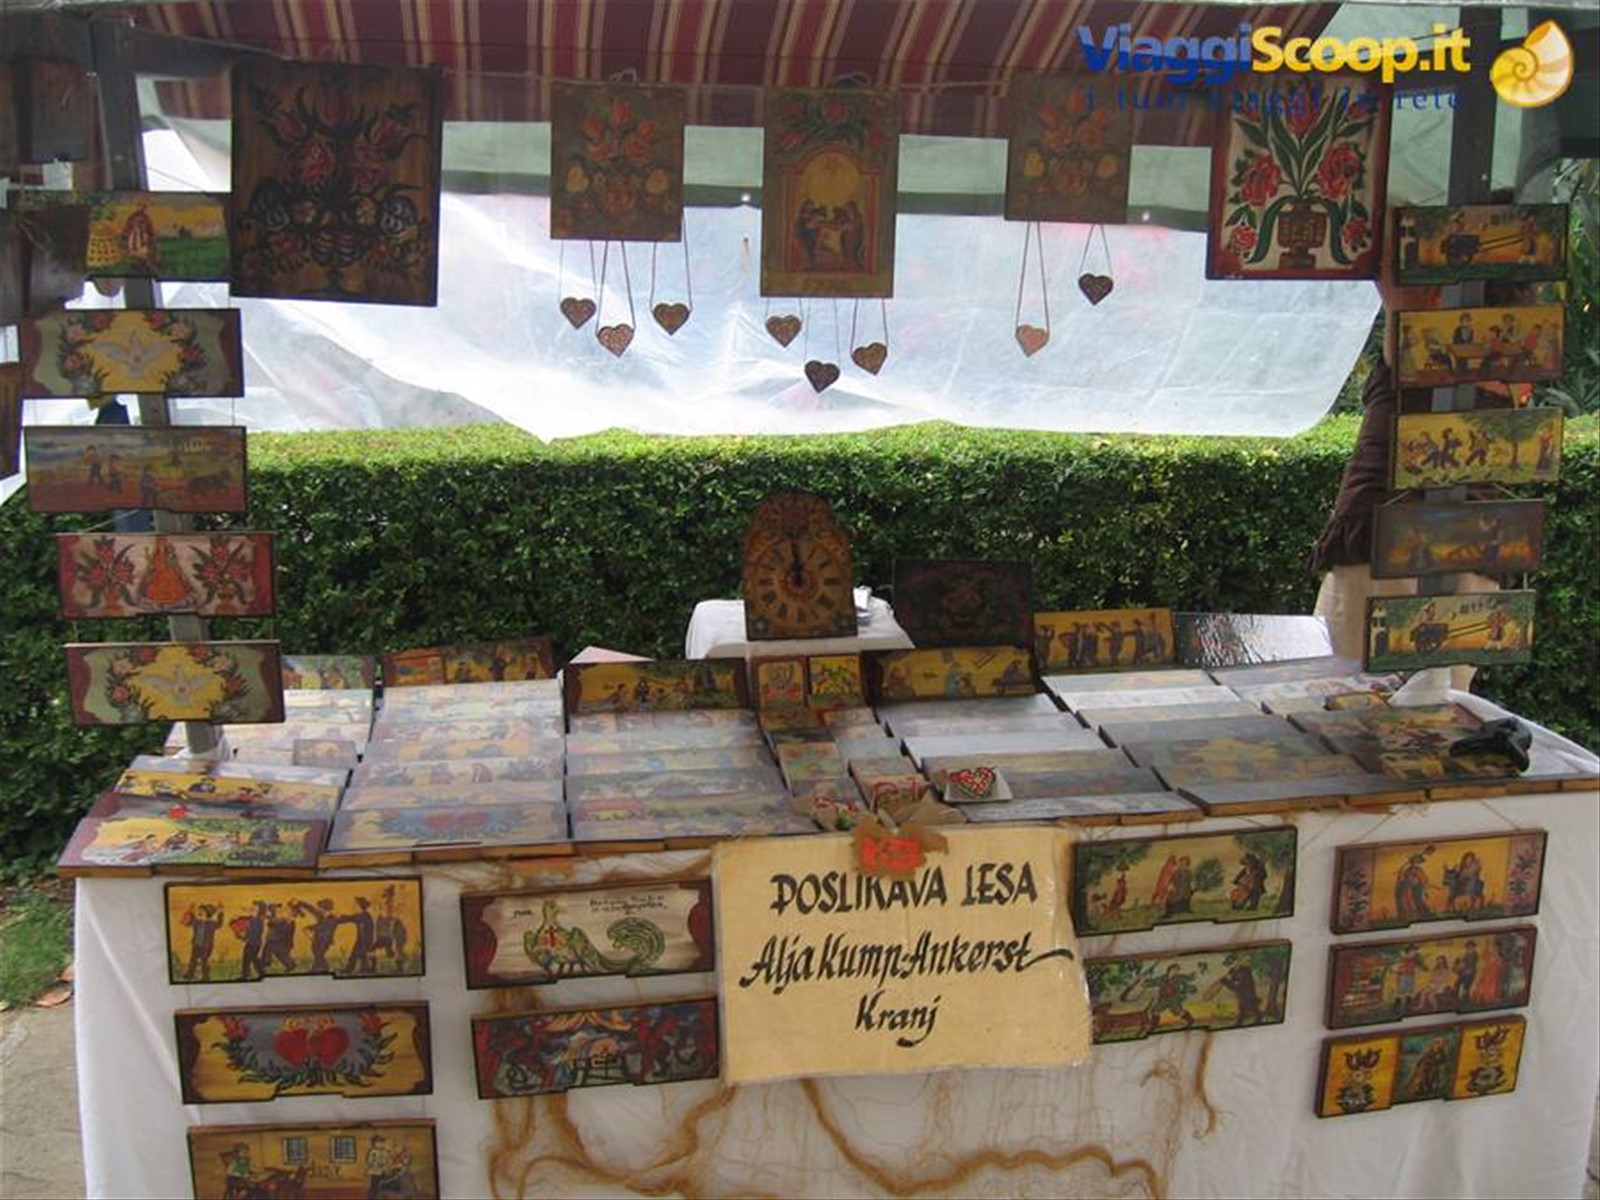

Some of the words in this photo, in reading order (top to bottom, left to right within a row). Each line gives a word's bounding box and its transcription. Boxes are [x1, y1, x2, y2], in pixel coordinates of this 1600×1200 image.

[770, 867, 947, 916] POSLIKAVA
[960, 862, 1037, 907] LESA
[855, 991, 941, 1047] Kranj
